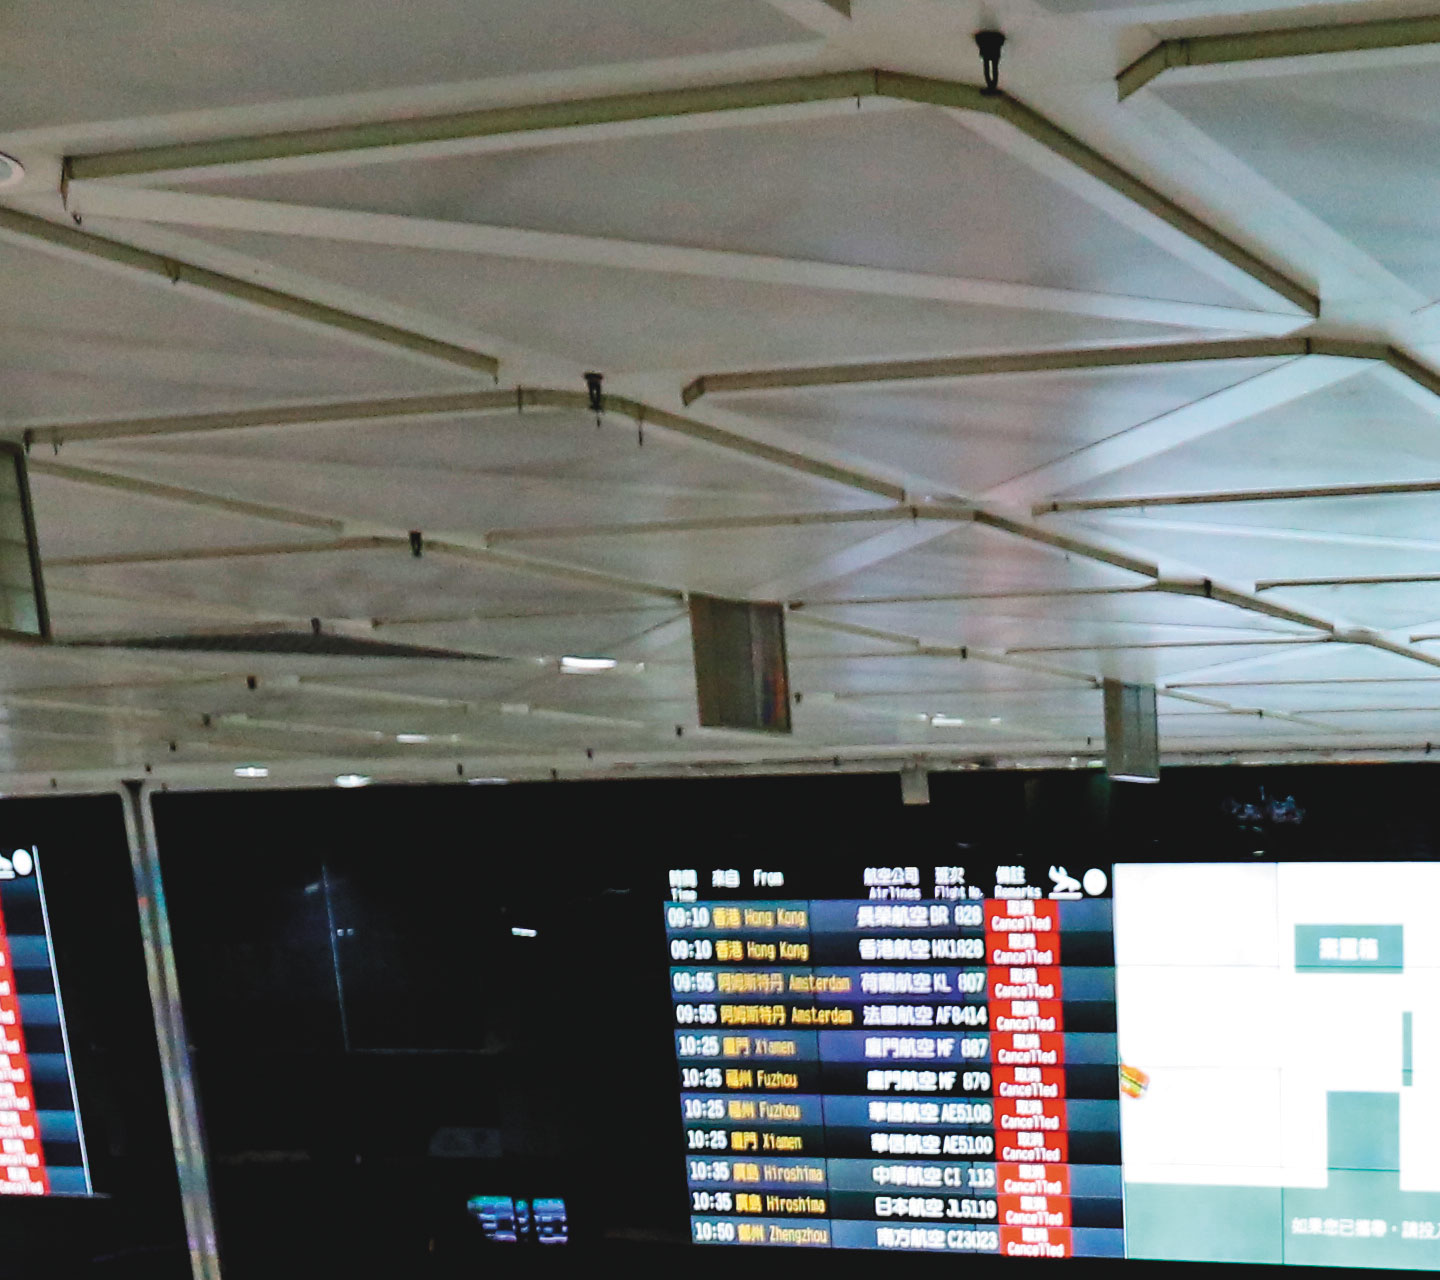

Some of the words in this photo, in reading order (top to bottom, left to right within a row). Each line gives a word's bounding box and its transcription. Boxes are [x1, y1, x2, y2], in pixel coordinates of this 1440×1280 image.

[668, 907, 709, 928] 09:10
[745, 909, 774, 927] Hong
[777, 908, 807, 926] Kong
[671, 940, 712, 959] 09:10
[716, 940, 744, 961] 香港
[747, 942, 776, 961] Hong
[780, 942, 808, 961] Kong
[674, 972, 715, 992] 09:55
[789, 975, 851, 992] Amsterdam
[676, 1004, 717, 1024] 09:55
[792, 1007, 854, 1025] Amsterdam
[679, 1036, 719, 1056] 10:25
[682, 1069, 722, 1087] 10:25
[757, 1070, 798, 1088] Fuzhou
[963, 1072, 990, 1090] 879
[685, 1099, 725, 1119] 10:25
[760, 1102, 801, 1120] Fuzhou
[688, 1130, 727, 1149] 10:25
[690, 1162, 730, 1180] 10:35
[764, 1165, 824, 1182] Hiroshima
[968, 1168, 995, 1187] 113
[693, 1192, 732, 1211] 10:35
[767, 1196, 826, 1213] Hiroshima
[695, 1222, 734, 1241] 10:50
[770, 1225, 827, 1243] Zhengzhou
